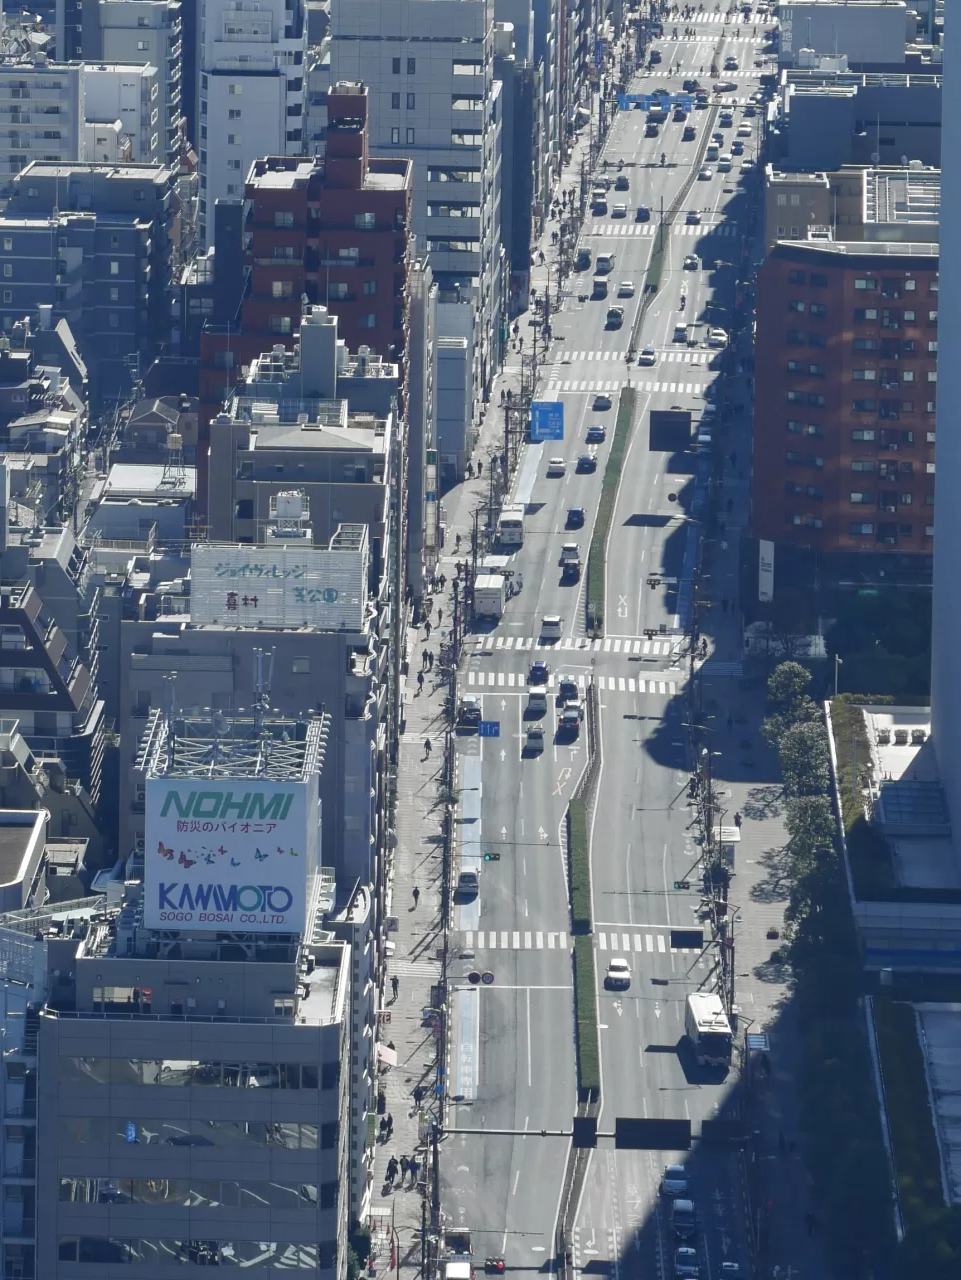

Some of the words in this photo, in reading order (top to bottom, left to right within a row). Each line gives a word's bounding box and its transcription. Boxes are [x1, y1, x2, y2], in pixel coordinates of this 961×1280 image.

[160, 790, 295, 820] NOHMI
[177, 820, 277, 834] 防災のパイオニア
[159, 912, 193, 922] SOGO
[199, 912, 234, 923] BOSAI
